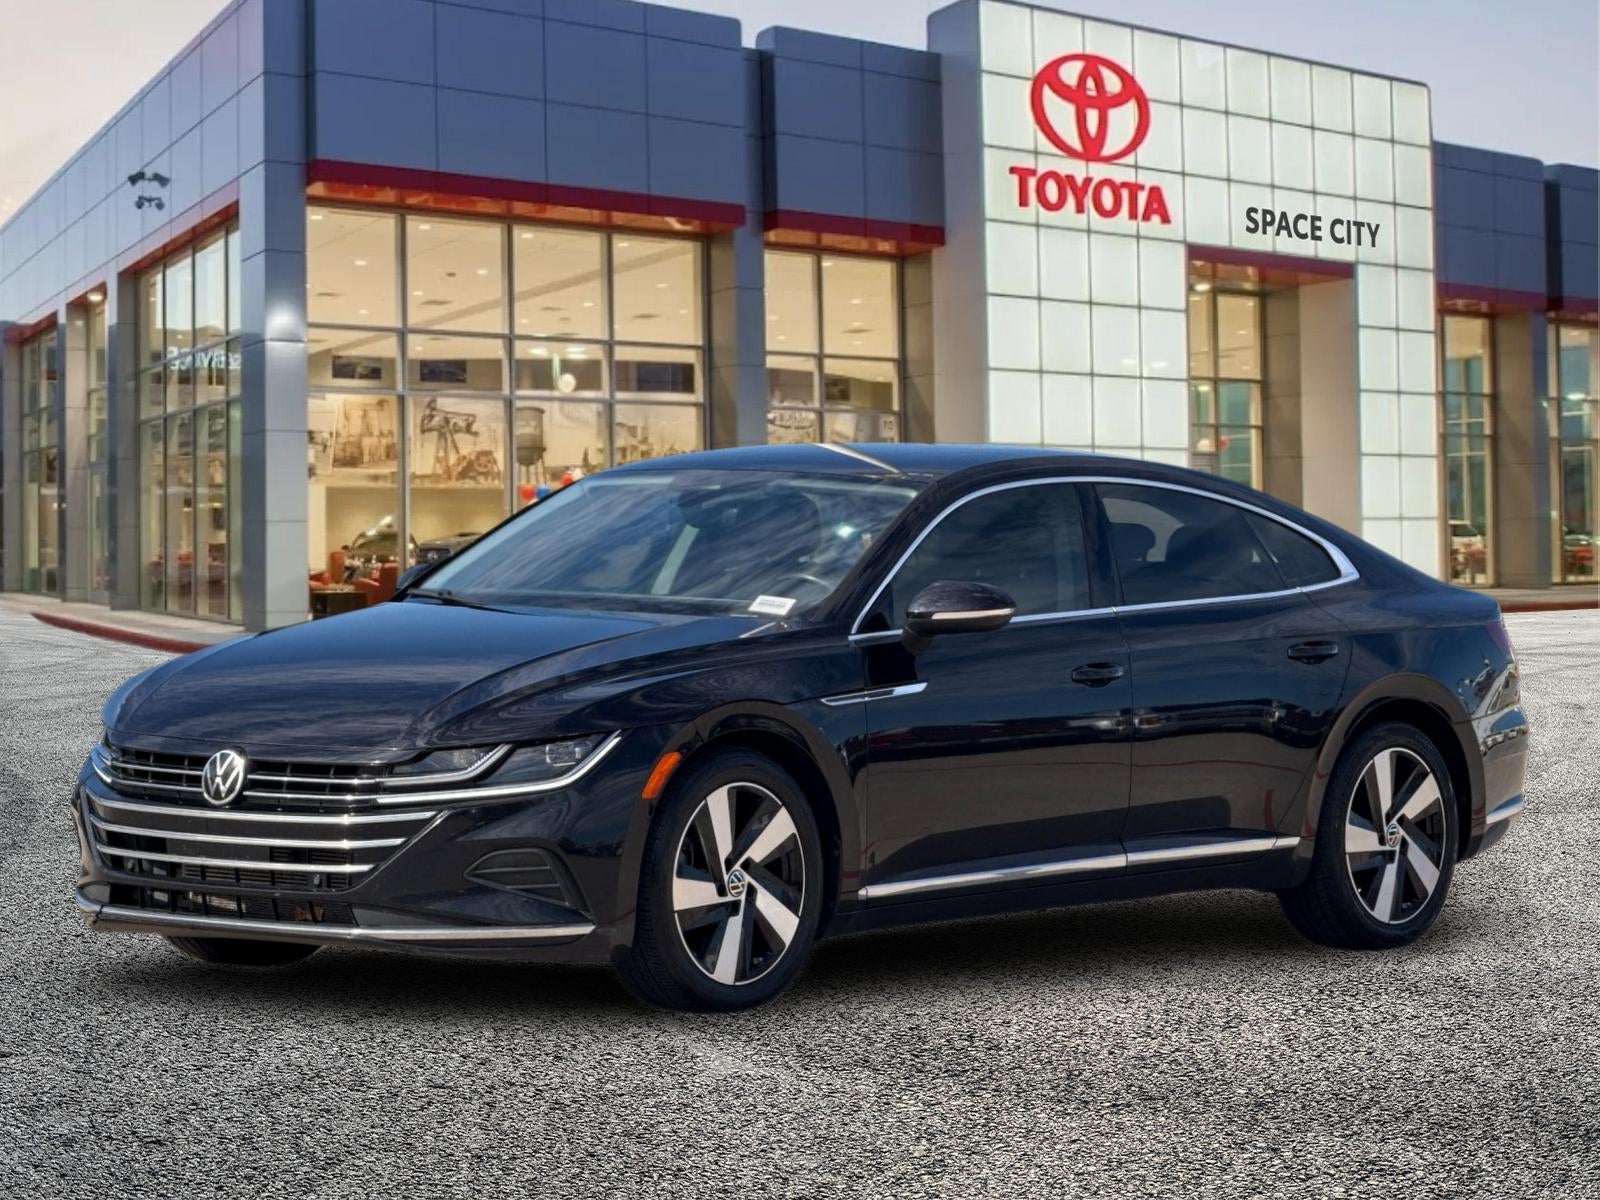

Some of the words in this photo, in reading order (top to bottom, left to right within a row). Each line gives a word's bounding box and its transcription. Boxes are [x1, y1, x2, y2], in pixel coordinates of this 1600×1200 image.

[1009, 166, 1171, 224] TOYOTA
[1245, 206, 1322, 241] SPACE
[1329, 218, 1380, 247] CITY
